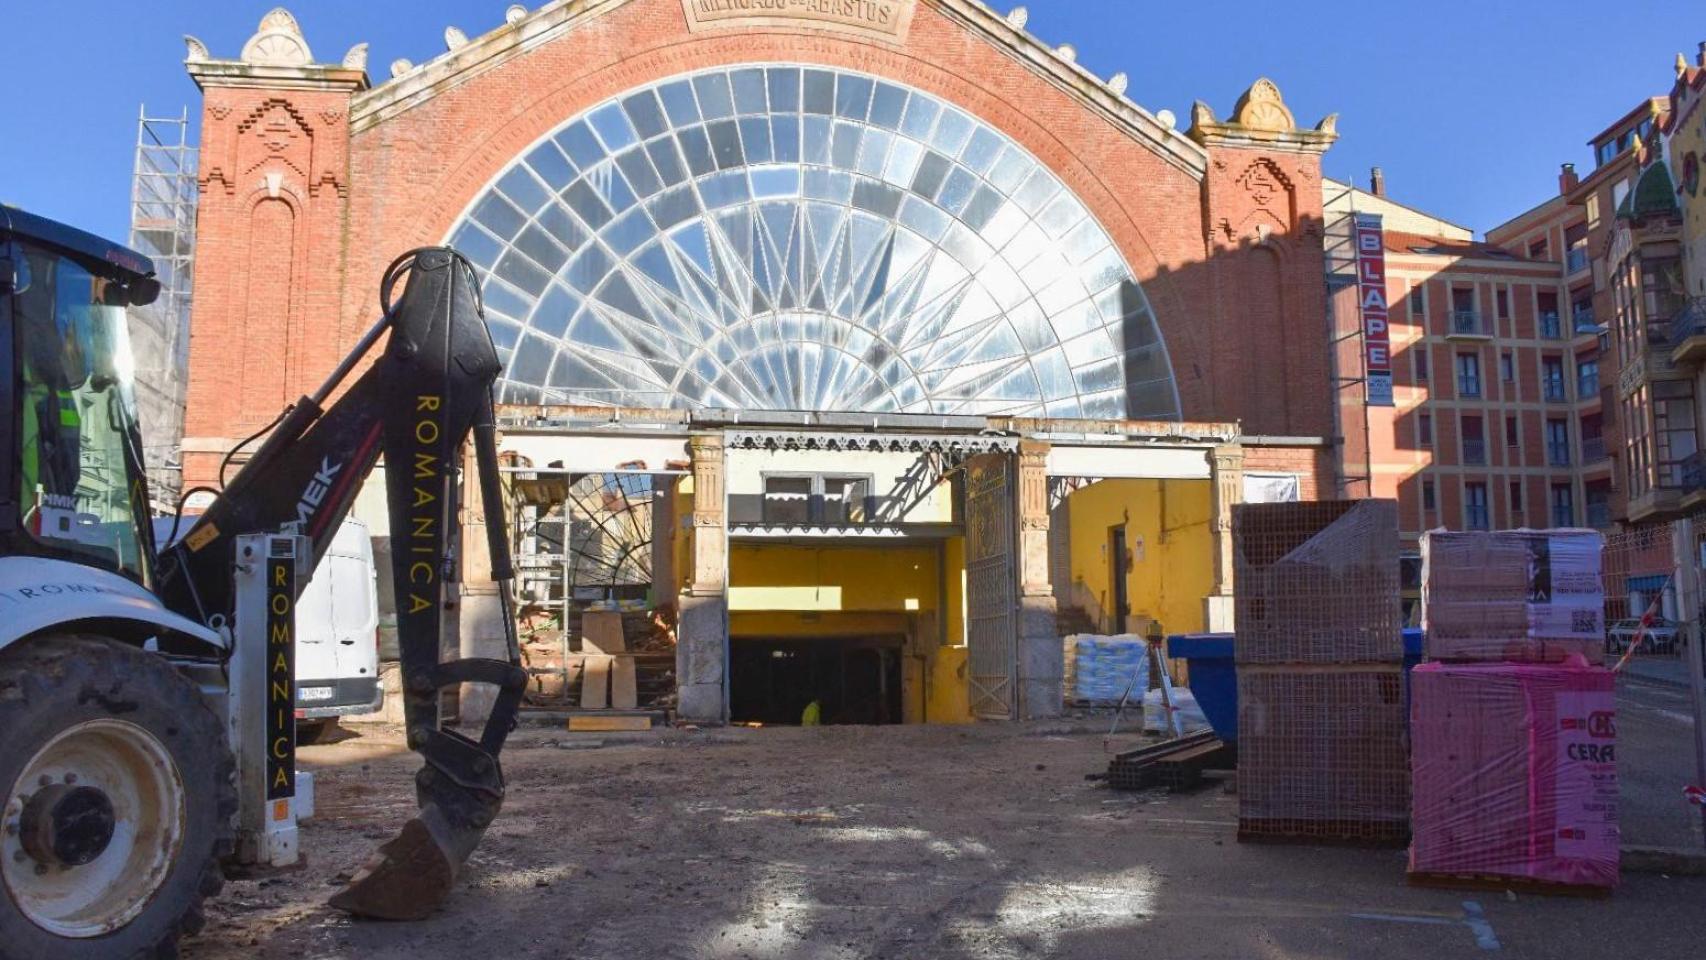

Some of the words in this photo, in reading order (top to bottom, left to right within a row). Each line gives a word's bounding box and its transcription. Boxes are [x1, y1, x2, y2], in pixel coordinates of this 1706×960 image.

[1360, 234, 1388, 365] BLAPE
[404, 396, 440, 614] ROMANICA
[271, 564, 290, 790] ROMANICA
